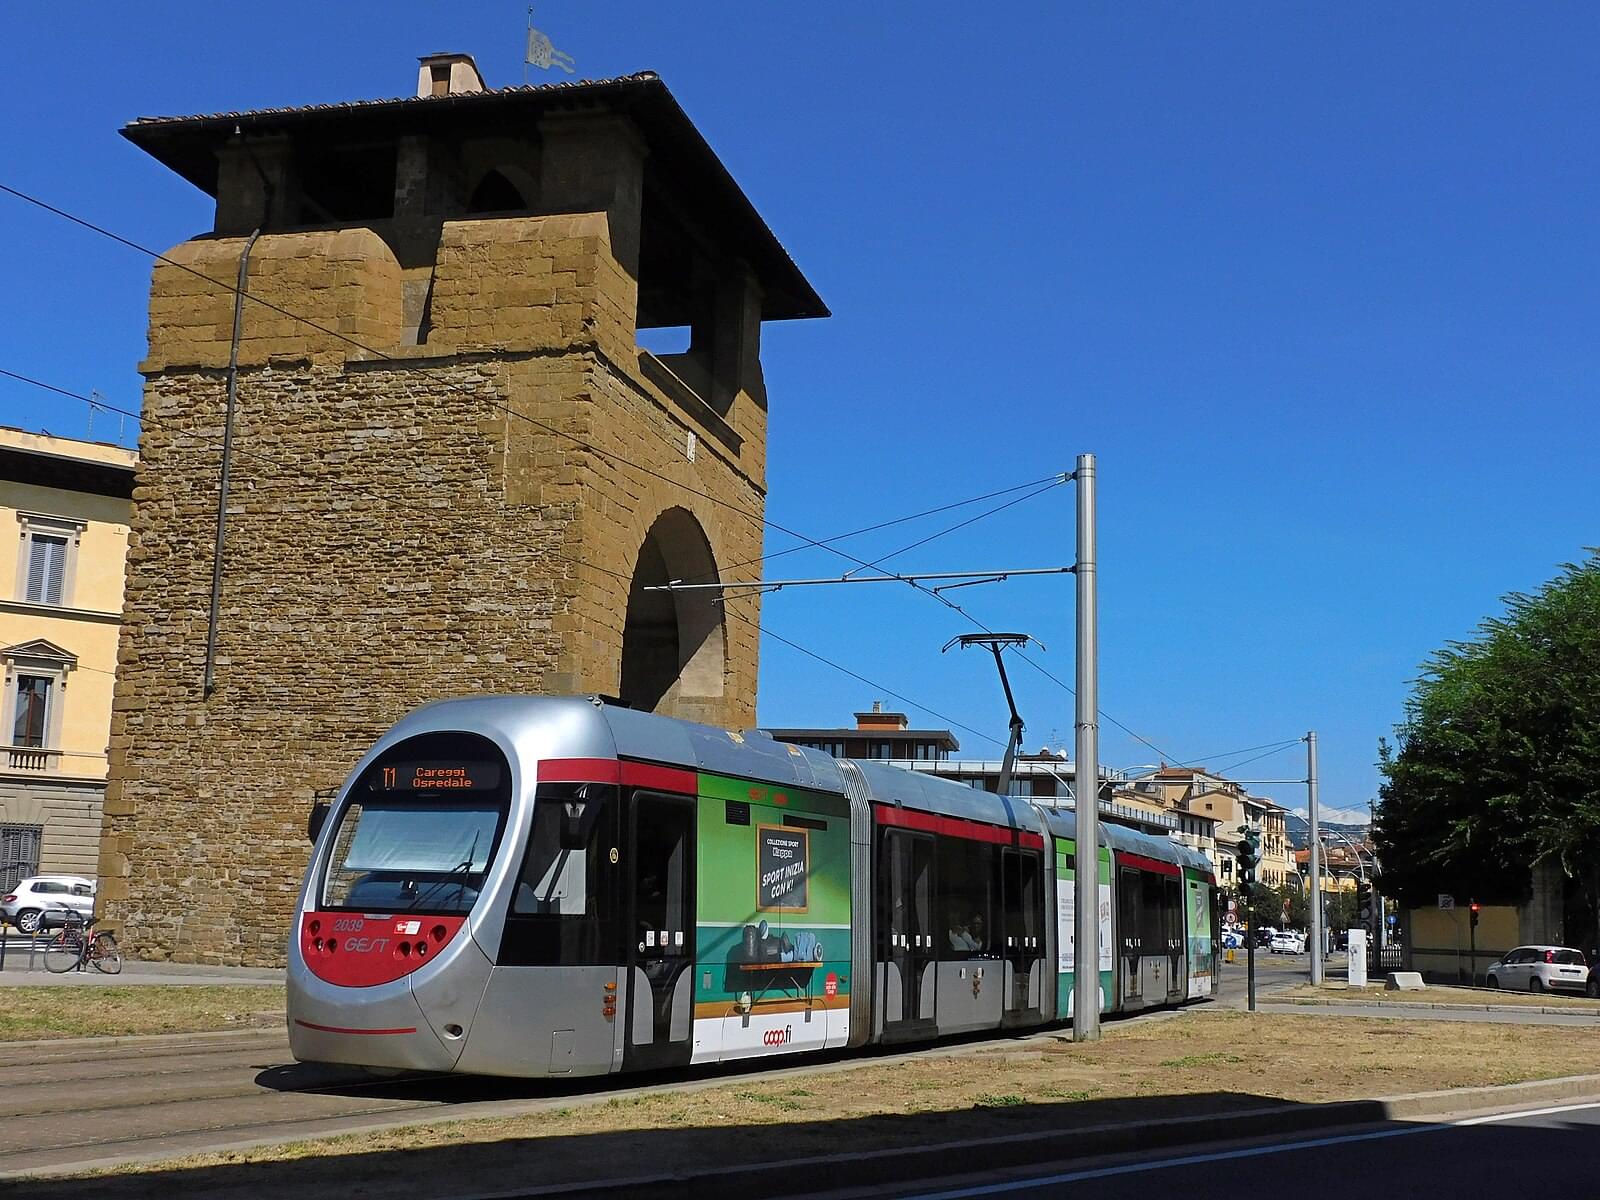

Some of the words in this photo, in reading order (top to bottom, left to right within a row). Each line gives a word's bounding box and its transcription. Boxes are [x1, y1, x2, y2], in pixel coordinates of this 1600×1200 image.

[383, 767, 396, 787] T1
[416, 767, 465, 777] Careggi
[412, 778, 472, 788] Ospedale
[767, 838, 788, 847] COLLEZIONE
[762, 867, 785, 887] SPORT
[785, 861, 804, 879] INIZIA
[771, 882, 786, 898] CON
[786, 879, 794, 892] K!
[333, 919, 364, 932] 2039
[344, 937, 390, 953] GEST
